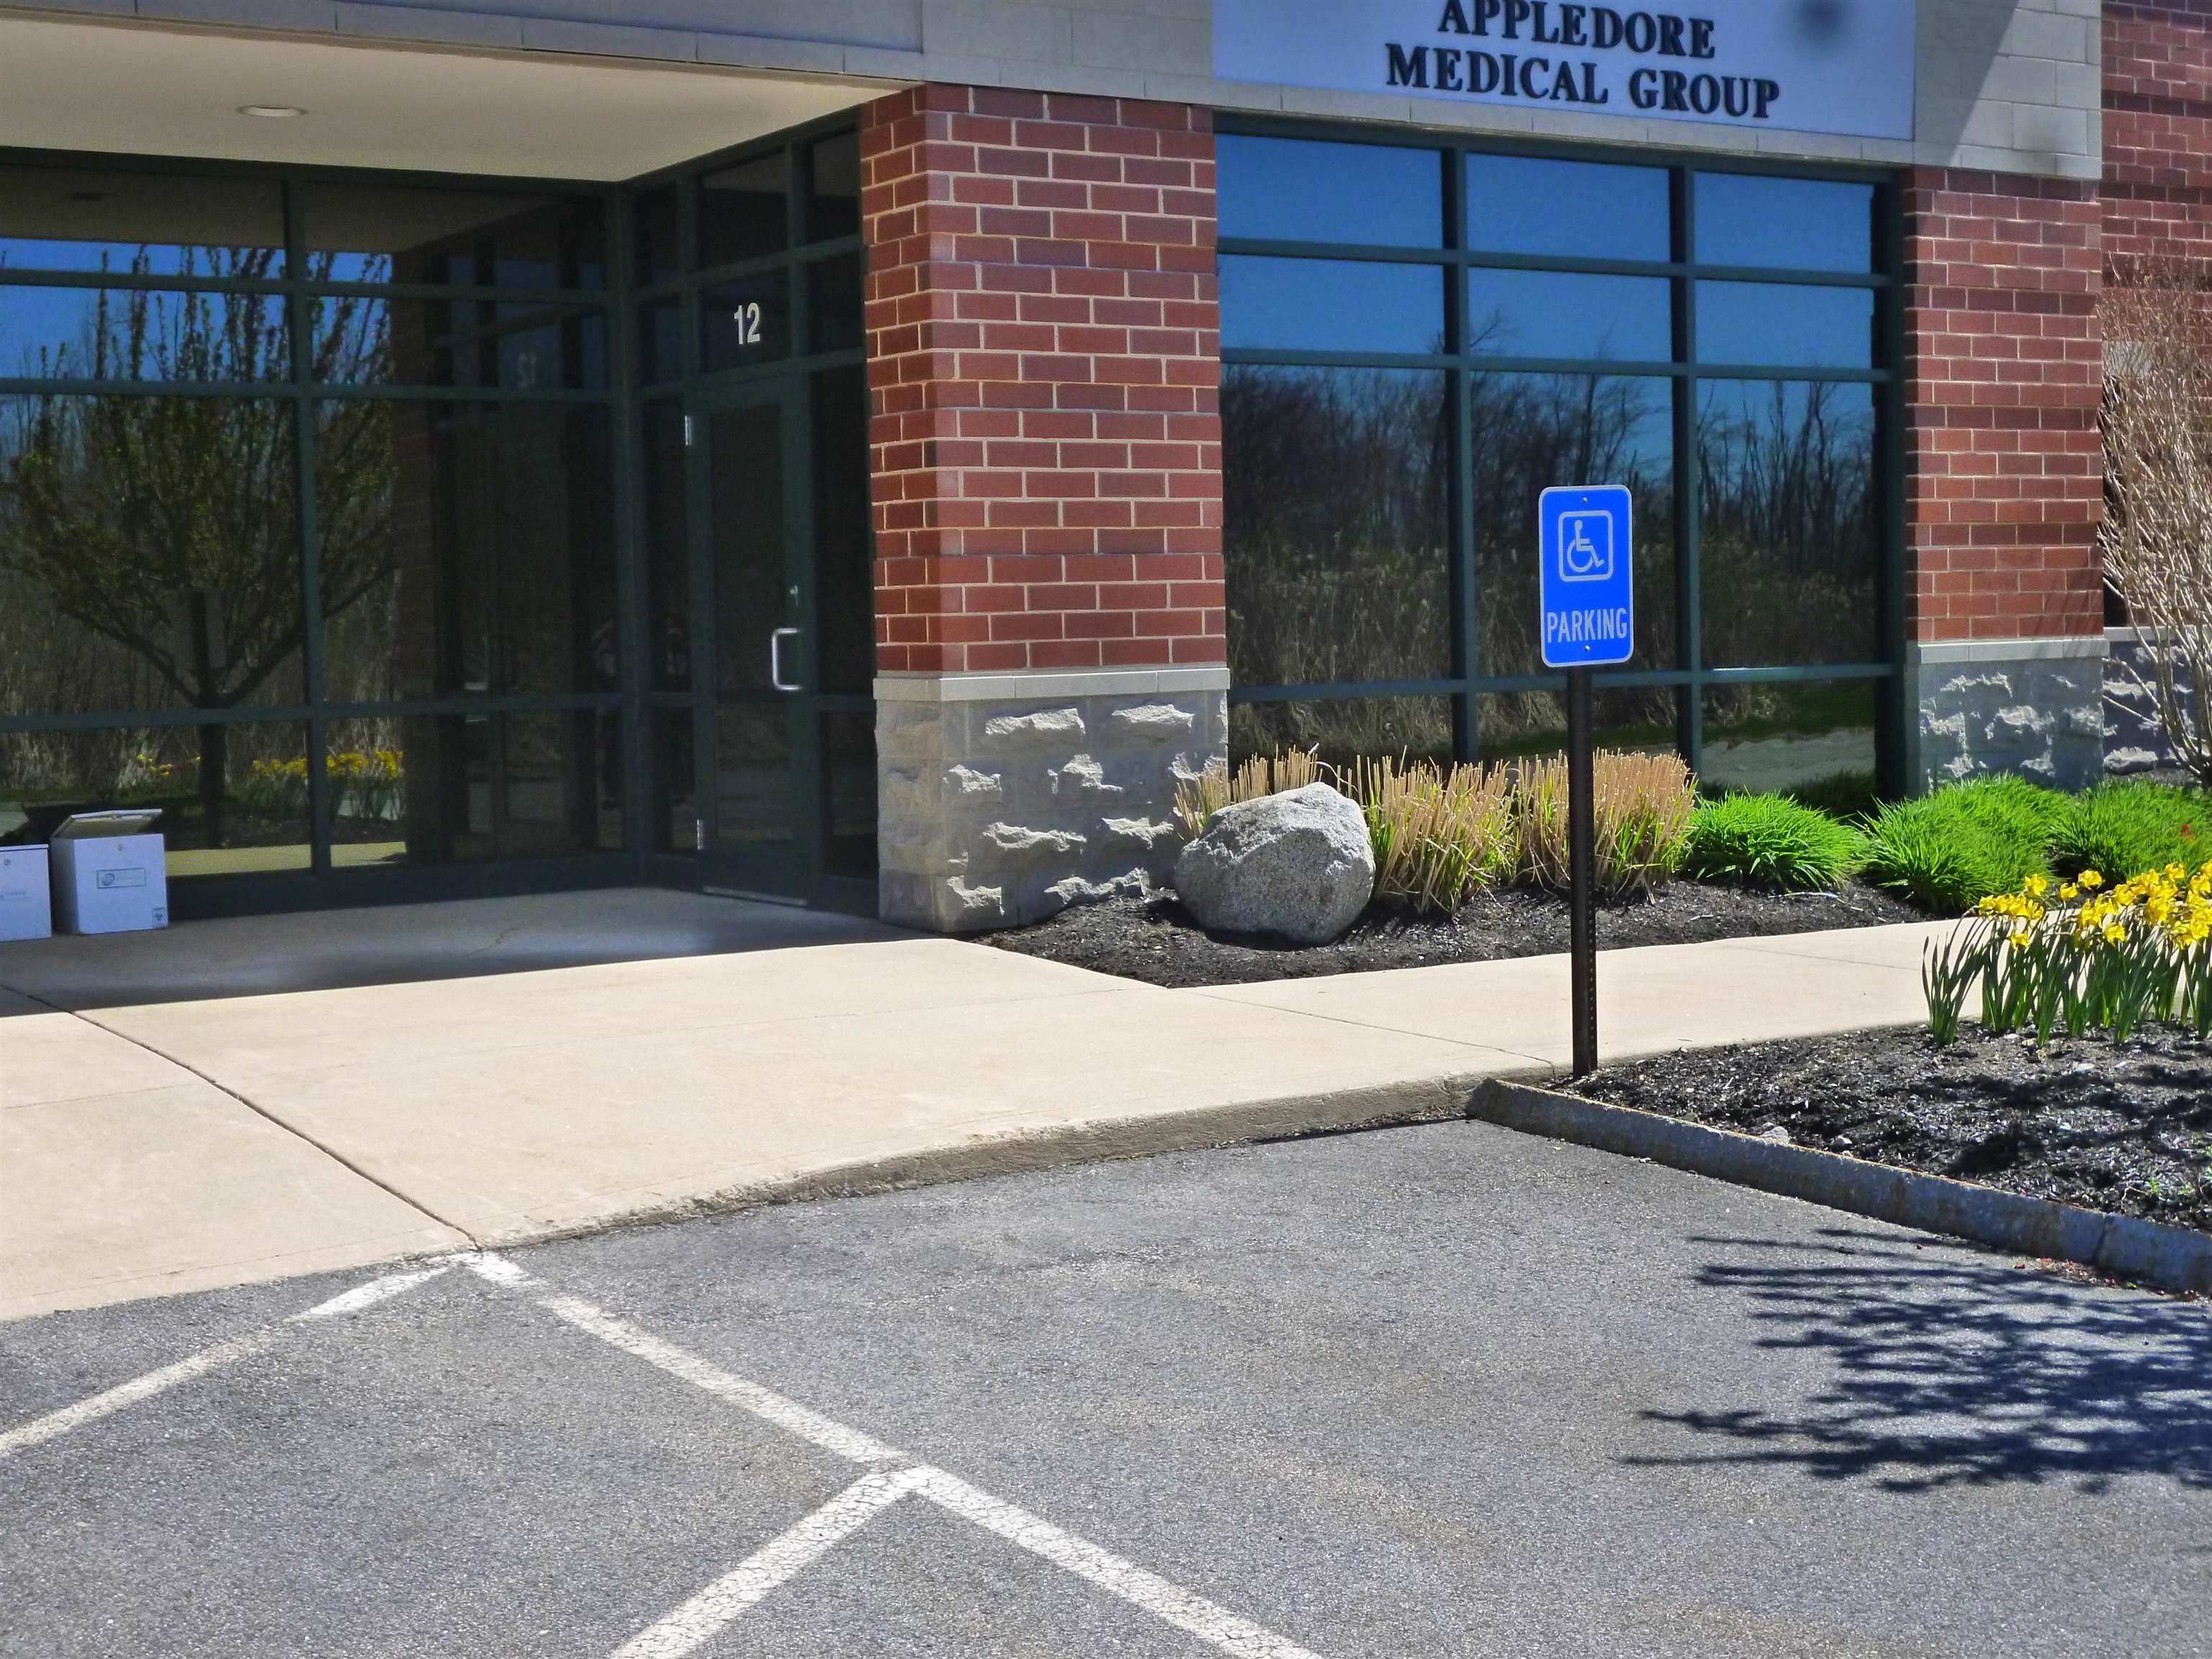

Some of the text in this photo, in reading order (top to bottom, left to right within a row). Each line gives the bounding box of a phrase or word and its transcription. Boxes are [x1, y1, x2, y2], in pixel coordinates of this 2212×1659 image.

[1437, 0, 1715, 59] APPLEDORE
[1385, 42, 1780, 118] MEDICAL GROUP
[734, 302, 760, 345] 12
[1547, 607, 1627, 643] PARKING
